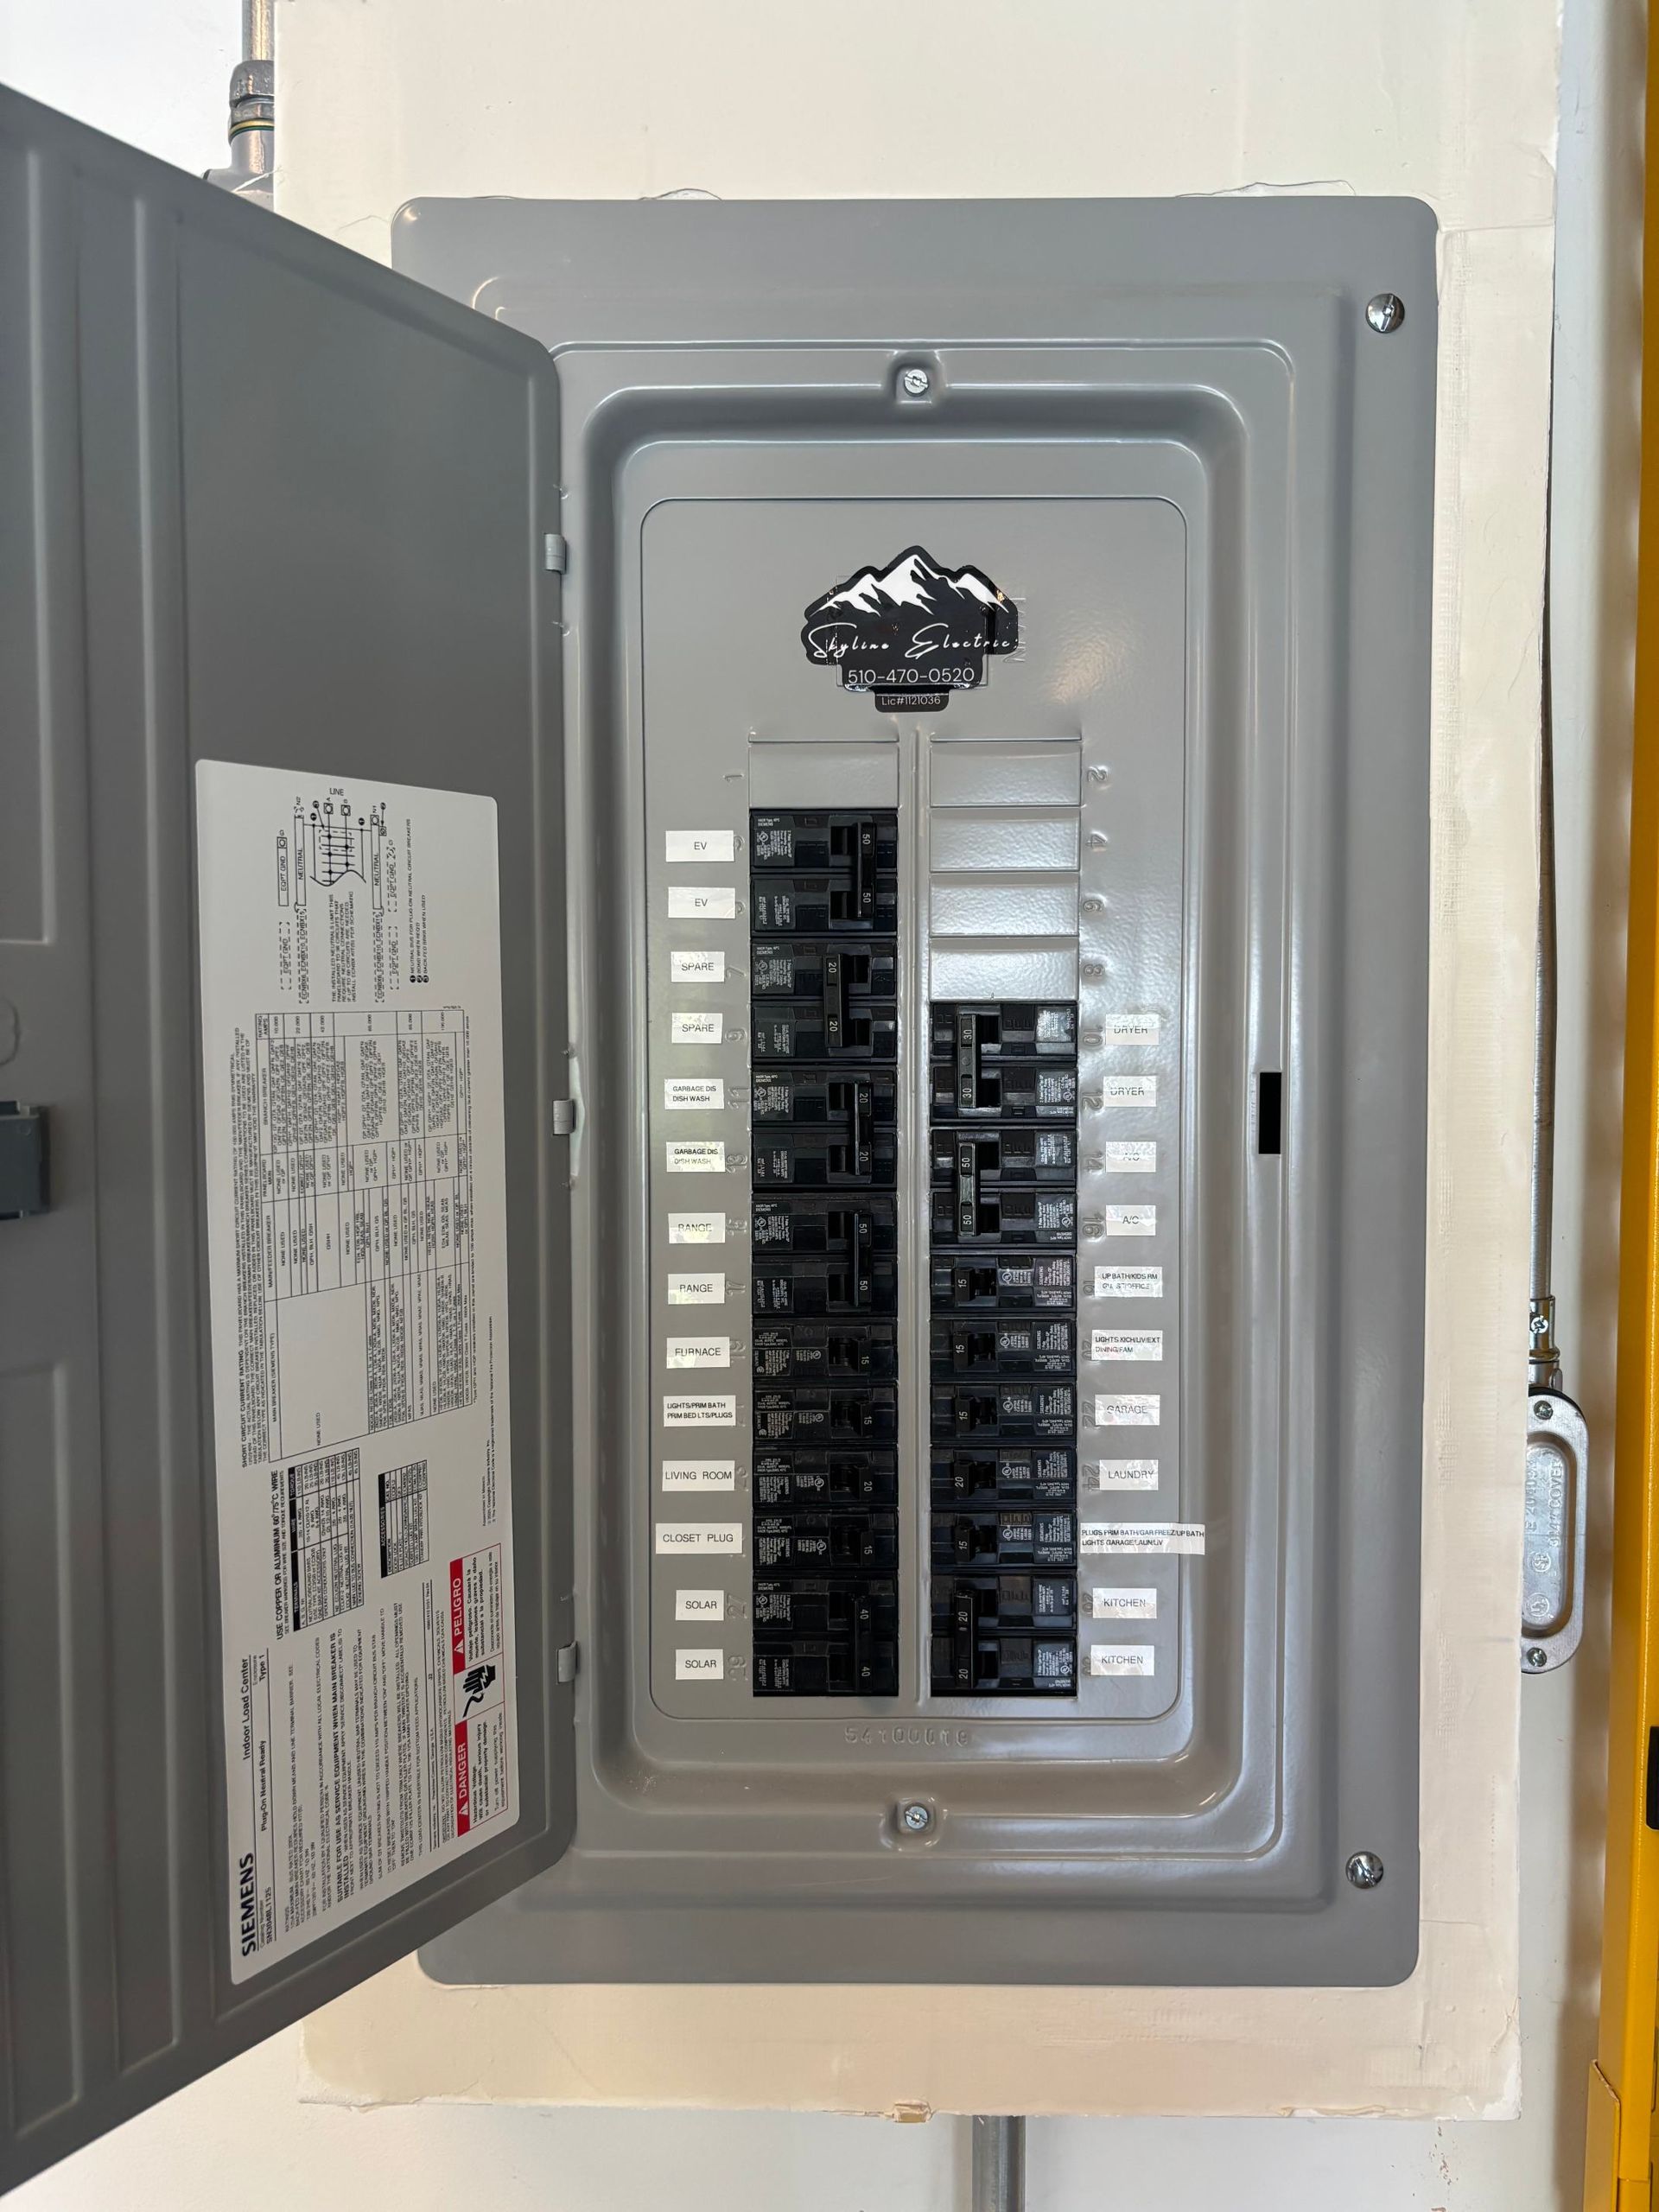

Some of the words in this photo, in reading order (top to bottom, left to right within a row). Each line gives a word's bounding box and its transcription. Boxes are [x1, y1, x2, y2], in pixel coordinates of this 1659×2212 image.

[808, 622, 890, 659] Skyline
[904, 622, 1011, 660] Electric
[848, 667, 975, 683] 510-470-0520
[881, 696, 941, 706] Lic#1121036
[328, 787, 345, 797] LINE
[862, 834, 871, 845] 50
[694, 842, 707, 850] EV
[695, 899, 708, 907] EV
[862, 893, 871, 904] 50
[681, 963, 715, 971] SPARE
[829, 962, 836, 973] 20
[830, 1021, 838, 1033] 20
[1114, 1025, 1148, 1034] DRYER
[963, 1029, 972, 1040] 30
[963, 1087, 972, 1098] 30
[1110, 1087, 1145, 1096] DRYER
[859, 1093, 868, 1104] 20
[859, 1151, 868, 1162] 20
[962, 1157, 970, 1168] 50
[963, 1214, 972, 1225] 50
[1122, 1216, 1140, 1224] A/C
[677, 1224, 712, 1232] RANGE
[859, 1224, 868, 1234] 50
[679, 1284, 713, 1293] RANGE
[860, 1281, 868, 1291] 50
[958, 1279, 967, 1288] 15
[675, 1347, 721, 1356] FURNACE
[956, 1344, 964, 1354] 15
[861, 1356, 869, 1365] 15
[1107, 1405, 1148, 1414] GARAGE
[864, 1416, 872, 1425] 15
[959, 1411, 968, 1421] 15
[665, 1471, 697, 1480] LIVING
[702, 1471, 732, 1479] ROOM
[1108, 1470, 1154, 1479] LAUNDRY
[864, 1481, 873, 1492] 20
[955, 1476, 963, 1488] 20
[1549, 1459, 1563, 1509] COVER
[663, 1534, 701, 1542] CLOSET
[707, 1534, 734, 1542] PLUG
[864, 1545, 873, 1554] 15
[959, 1541, 968, 1550] 15
[275, 1573, 282, 1585] OR
[453, 1578, 461, 1636] PELIGRO
[685, 1600, 717, 1609] SOLAR
[1103, 1599, 1146, 1607] KITCHEN
[860, 1609, 869, 1620] 40
[958, 1611, 968, 1623] 20
[685, 1660, 716, 1669] SOLAR
[1102, 1656, 1143, 1664] KITCHEN
[861, 1666, 870, 1677] 40
[958, 1669, 968, 1680] 20
[458, 1743, 467, 1799] DANGER
[239, 1853, 256, 1956] SIEMENS
